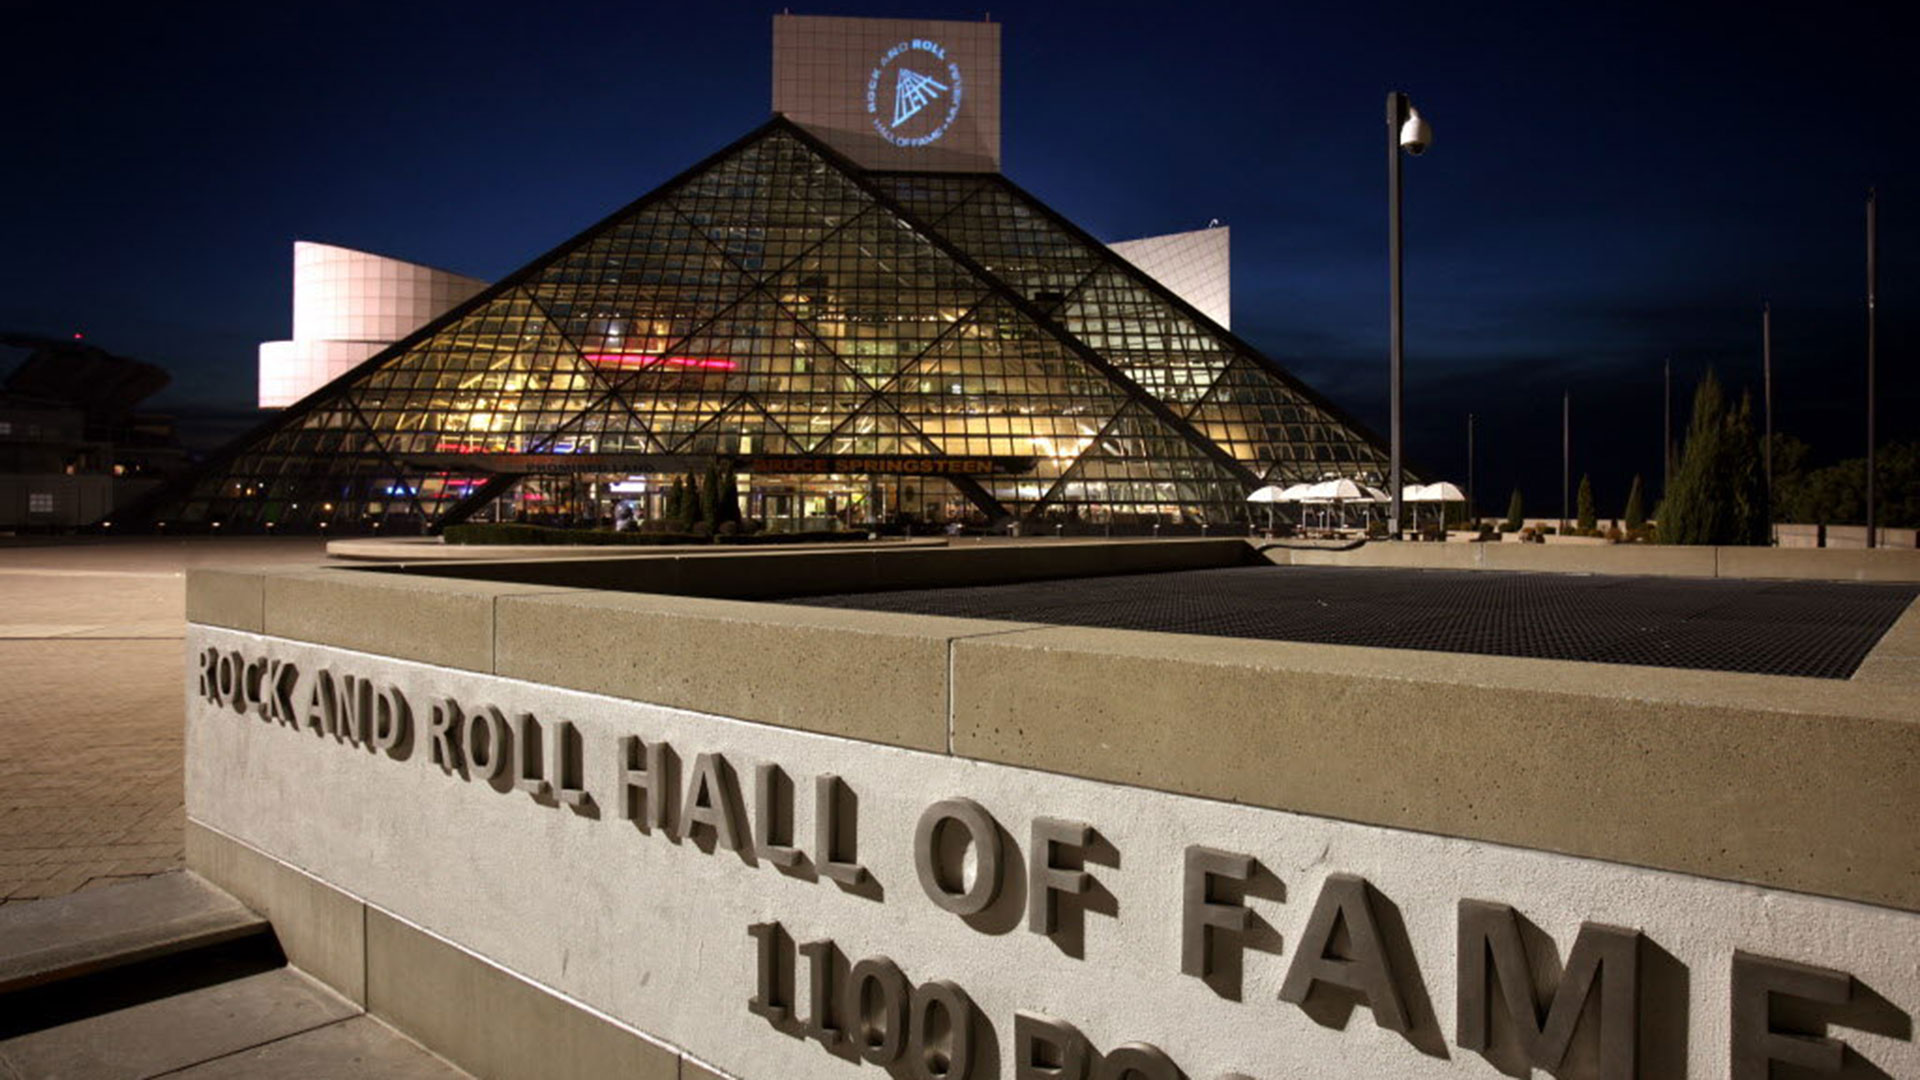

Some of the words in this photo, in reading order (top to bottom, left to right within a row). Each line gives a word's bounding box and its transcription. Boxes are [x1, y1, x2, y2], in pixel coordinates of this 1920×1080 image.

[866, 67, 881, 113] ROCK
[881, 42, 908, 67] AND
[911, 38, 945, 60] ROLL
[611, 463, 656, 473] LAND
[753, 458, 829, 473] BRUCE
[834, 458, 993, 474] SPRINGSTEEN
[199, 646, 297, 726] ROCK
[304, 669, 404, 753] AND
[427, 697, 589, 808] ROLL
[617, 734, 868, 886] HALL
[913, 796, 1094, 936] OF
[1180, 843, 1856, 1080] FAME
[747, 920, 977, 1080] 1100
